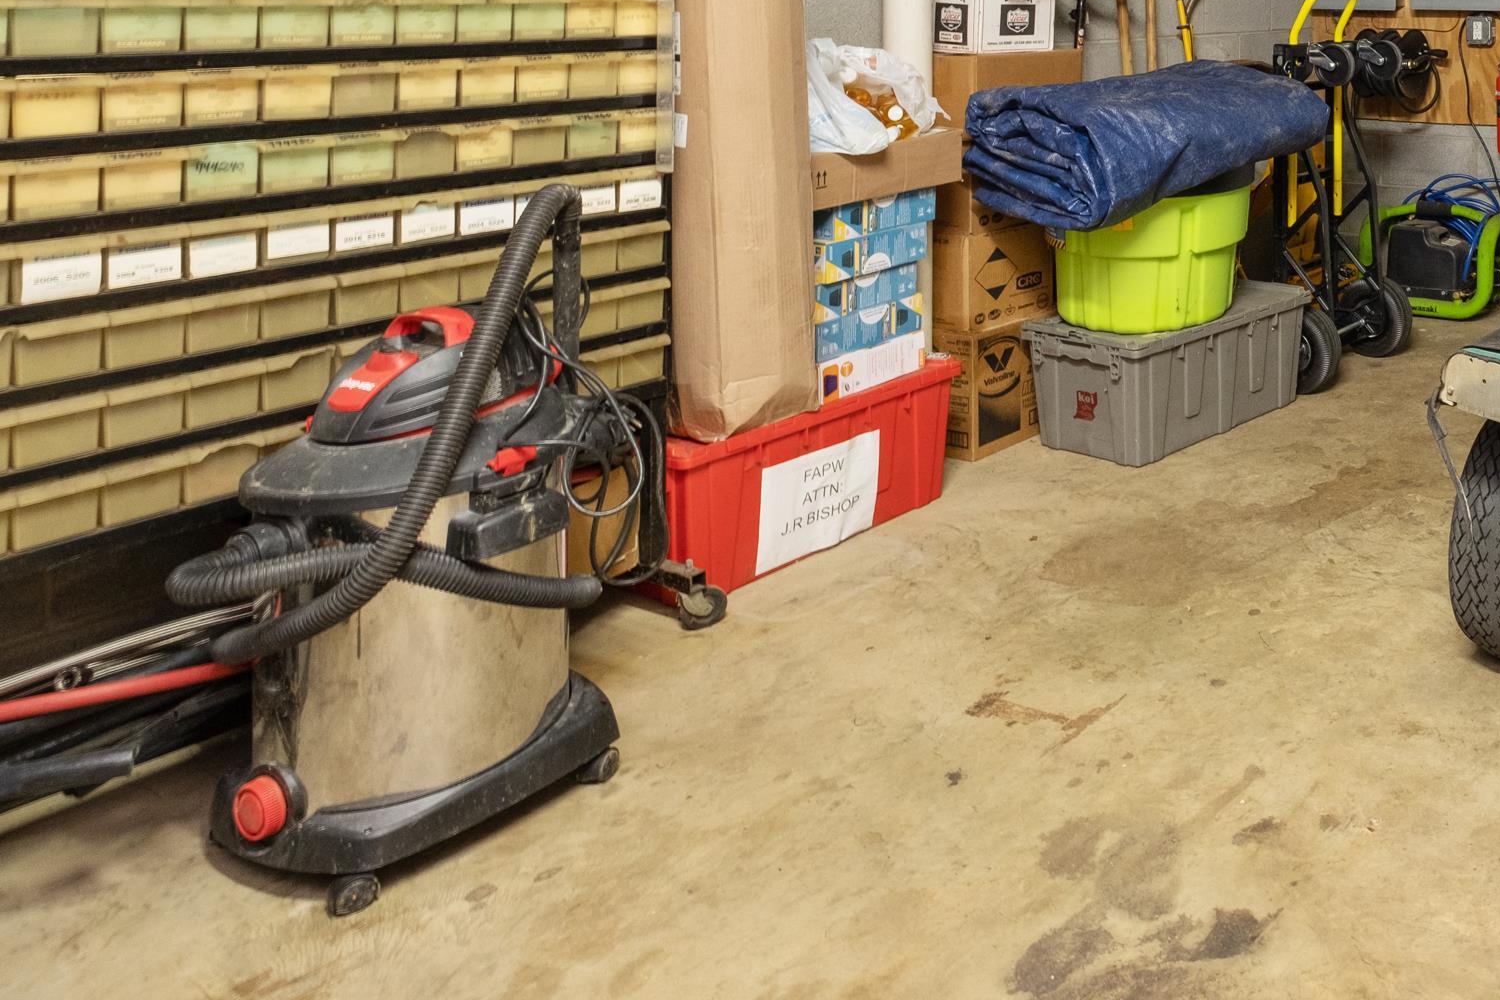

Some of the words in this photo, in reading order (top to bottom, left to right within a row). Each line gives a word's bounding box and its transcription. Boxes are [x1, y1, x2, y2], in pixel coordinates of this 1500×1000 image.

[1018, 273, 1041, 287] CRC
[1412, 305, 1437, 313] wasaki
[984, 370, 1016, 386] Valvoline
[803, 458, 845, 482] FAPW
[802, 481, 844, 505] ATTN:
[780, 516, 803, 536] J.R
[806, 495, 860, 525] BISHOP
